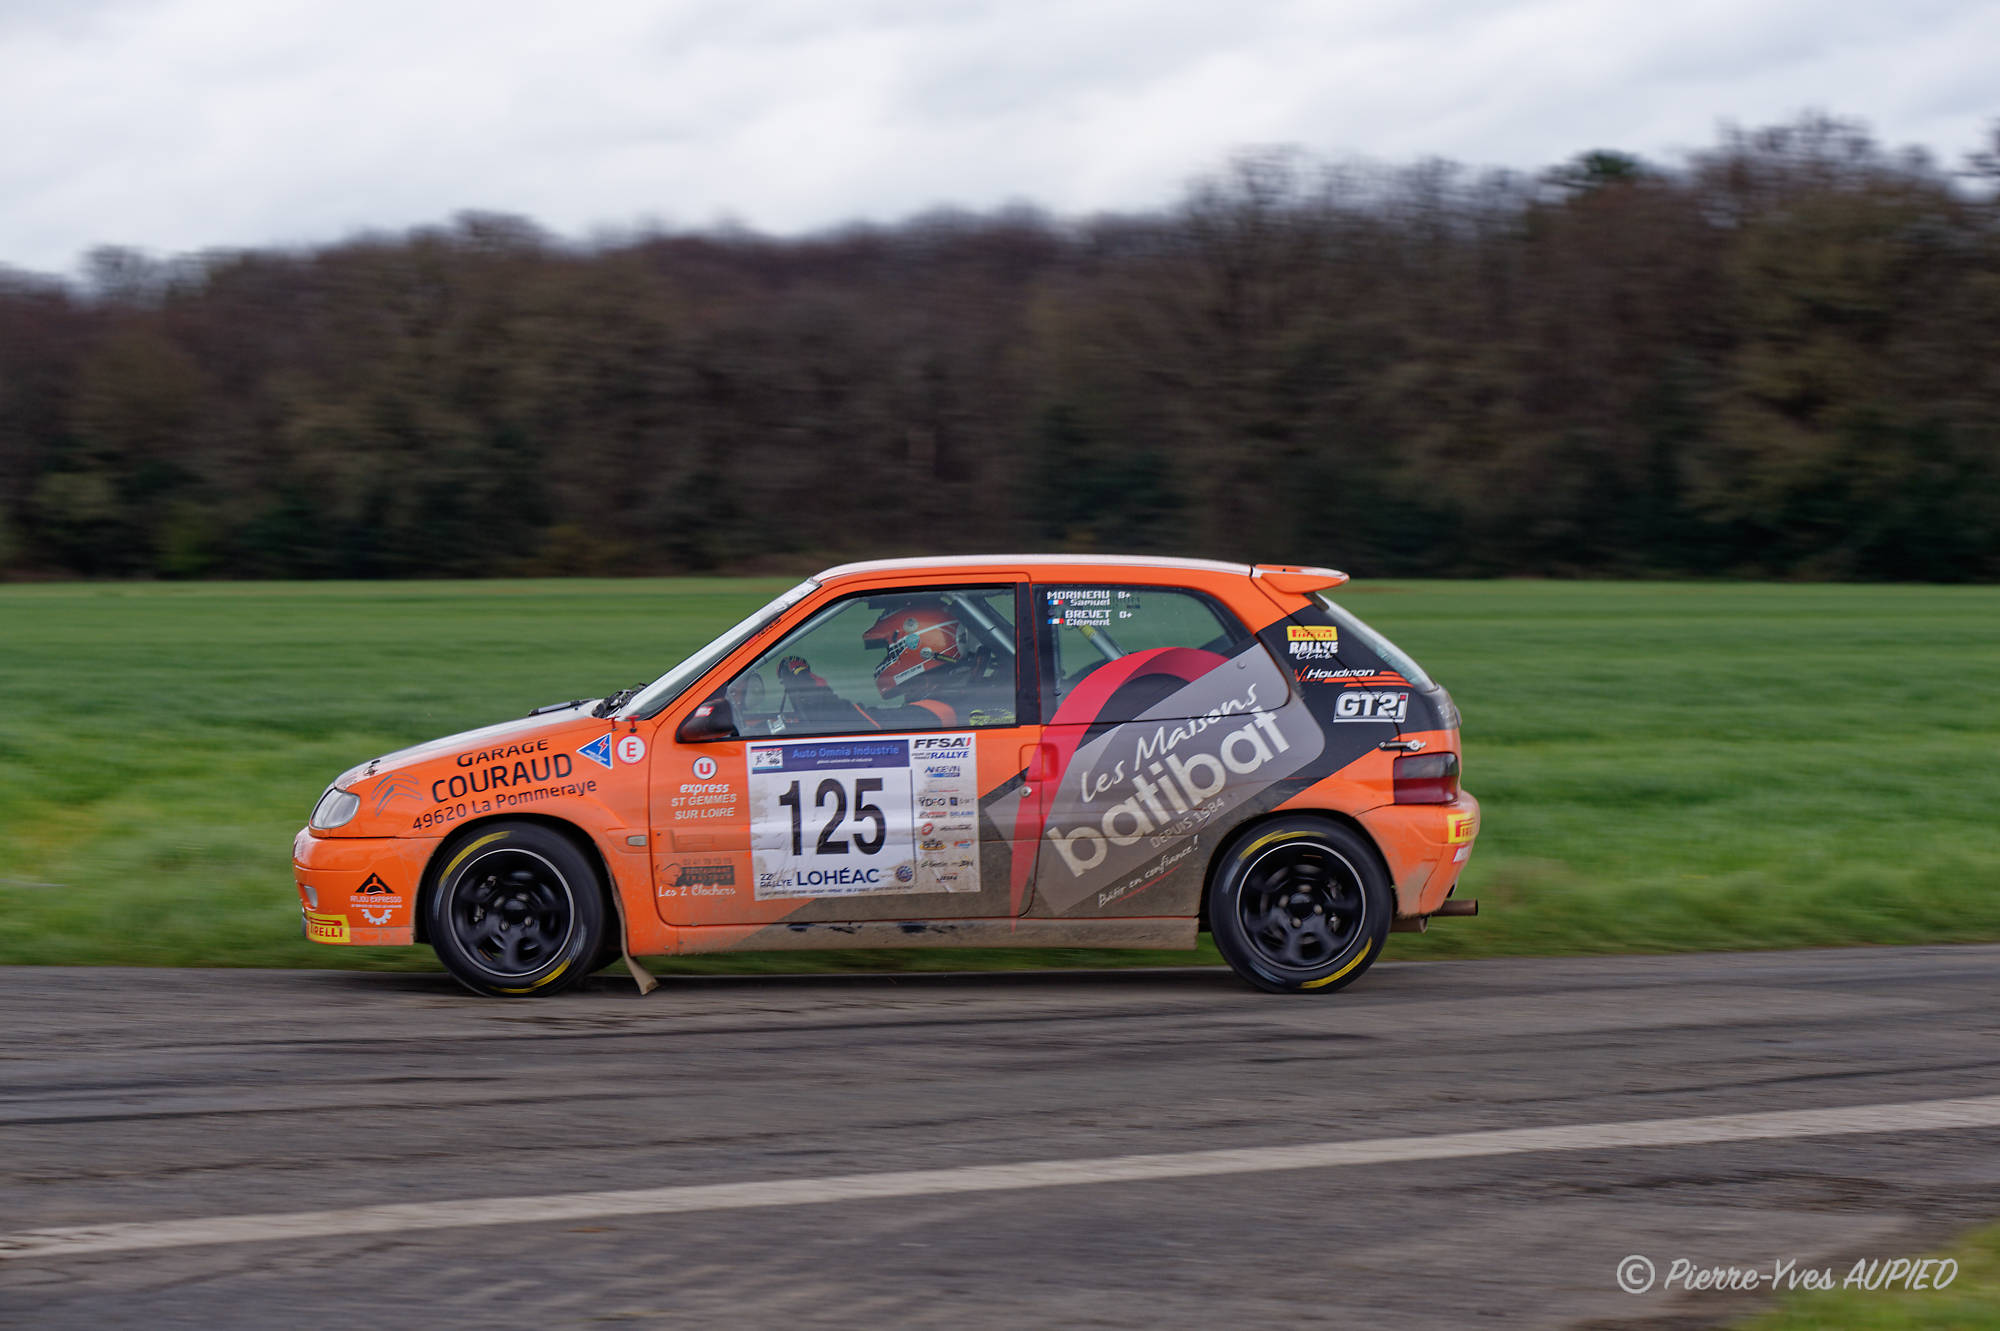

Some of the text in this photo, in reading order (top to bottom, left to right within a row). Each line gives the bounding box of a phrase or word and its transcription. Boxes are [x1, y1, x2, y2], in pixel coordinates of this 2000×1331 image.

[1047, 590, 1110, 600] MORINEAU
[1065, 610, 1112, 618] BREVET
[1289, 641, 1339, 654] RALLYE
[626, 742, 636, 757] E
[914, 737, 965, 748] FFSA
[1081, 683, 1257, 803] Les Maisons
[457, 738, 548, 767] GARAGE
[791, 748, 816, 759] Auto
[819, 746, 850, 757] Omnia
[853, 744, 899, 756] Industrie
[930, 751, 969, 759] RALLYE
[698, 763, 711, 775] U
[432, 753, 572, 803] COURAUD
[680, 783, 729, 796] express
[1047, 705, 1290, 878] batibat
[412, 780, 598, 831] 49620 La Pommeraye
[671, 793, 737, 807] ST GEMMES
[675, 807, 735, 820] SUR LOIRE
[779, 777, 886, 856] 125
[1150, 797, 1225, 848] DEPUIS 1984
[760, 879, 792, 888] RALLYE
[797, 867, 880, 886] LOHÉAC
[1129, 878, 1142, 888] en
[658, 887, 677, 897] Les
[681, 885, 689, 896] 2
